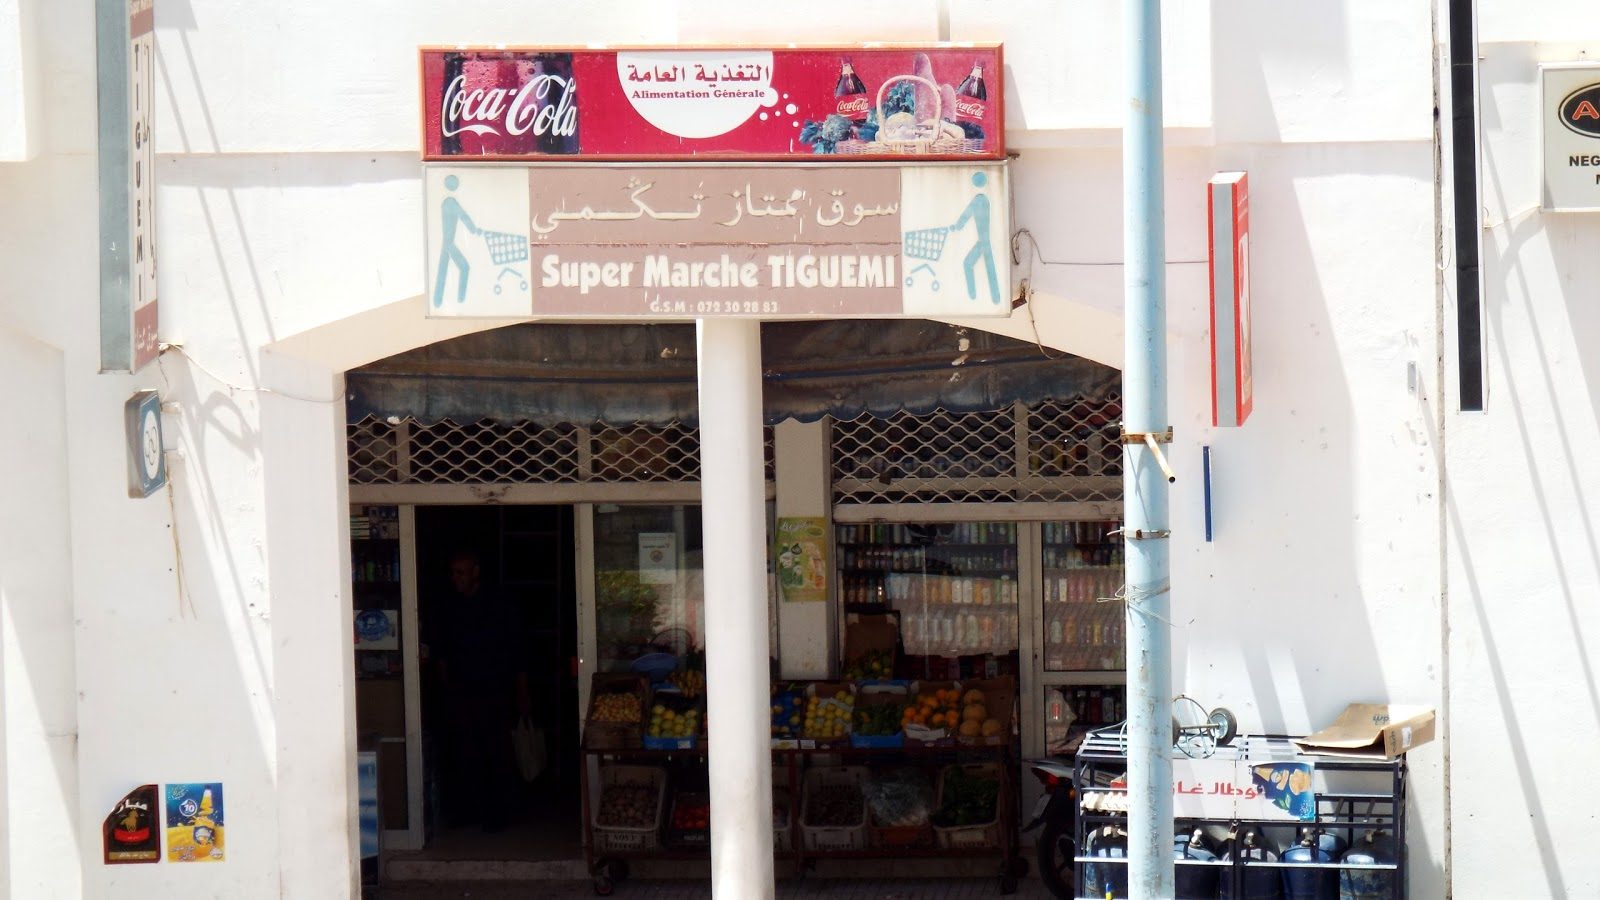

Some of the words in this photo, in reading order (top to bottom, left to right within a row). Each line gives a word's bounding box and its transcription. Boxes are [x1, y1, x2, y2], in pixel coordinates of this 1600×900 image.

[627, 63, 686, 83] العامة
[694, 64, 770, 88] التغذية
[441, 74, 577, 137] Coca-Cola
[632, 90, 710, 99] Alimentation
[713, 89, 765, 99] Générale
[714, 182, 804, 227] ممتاز
[815, 187, 900, 227] سوق
[541, 254, 634, 295] Super
[643, 254, 759, 288] Marche
[767, 254, 896, 289] TIGUEMI
[650, 301, 686, 313] G.S.M
[697, 301, 721, 313] 072
[724, 301, 740, 313] 30
[743, 301, 759, 313] 28
[762, 301, 778, 313] 83
